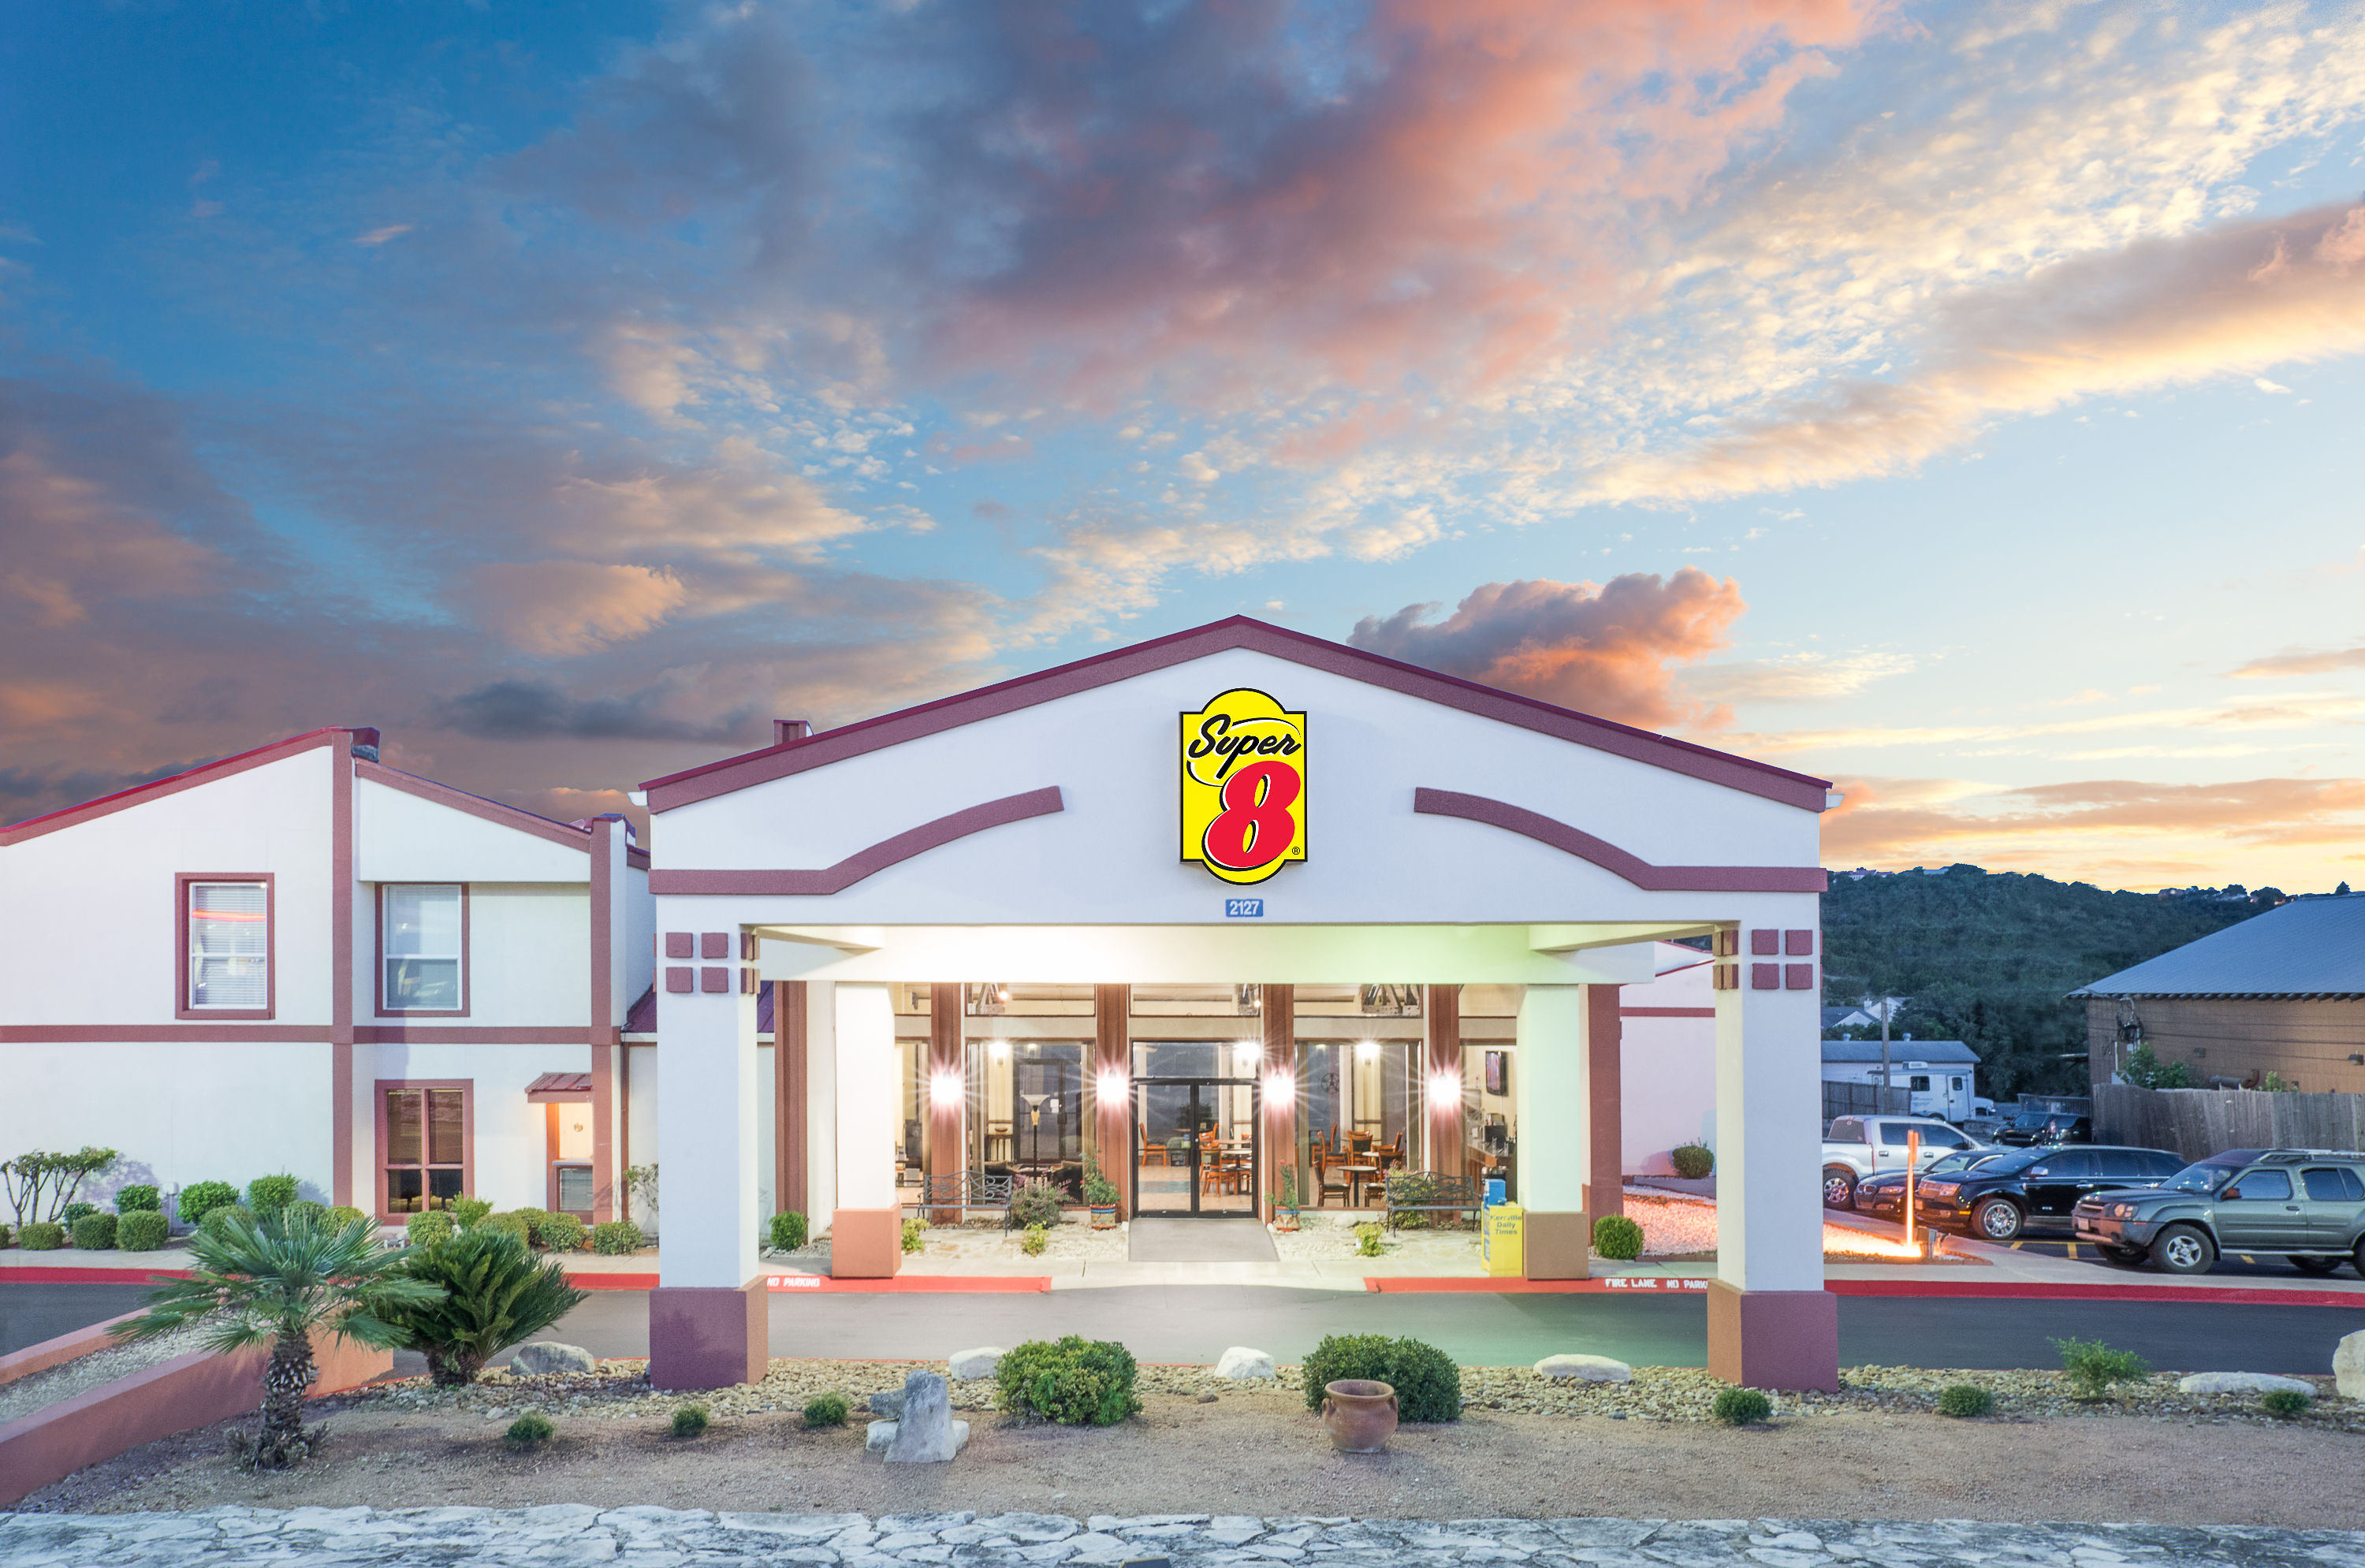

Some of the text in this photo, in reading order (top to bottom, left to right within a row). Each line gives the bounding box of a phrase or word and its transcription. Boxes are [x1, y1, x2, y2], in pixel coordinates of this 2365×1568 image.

[1186, 713, 1302, 780] Super
[1201, 760, 1301, 872] 8
[1229, 902, 1260, 916] 2127
[766, 1277, 820, 1287] NO PARKING
[1605, 1279, 1628, 1287] FIRE
[1631, 1279, 1658, 1287] LANE
[1666, 1279, 1679, 1288] NO
